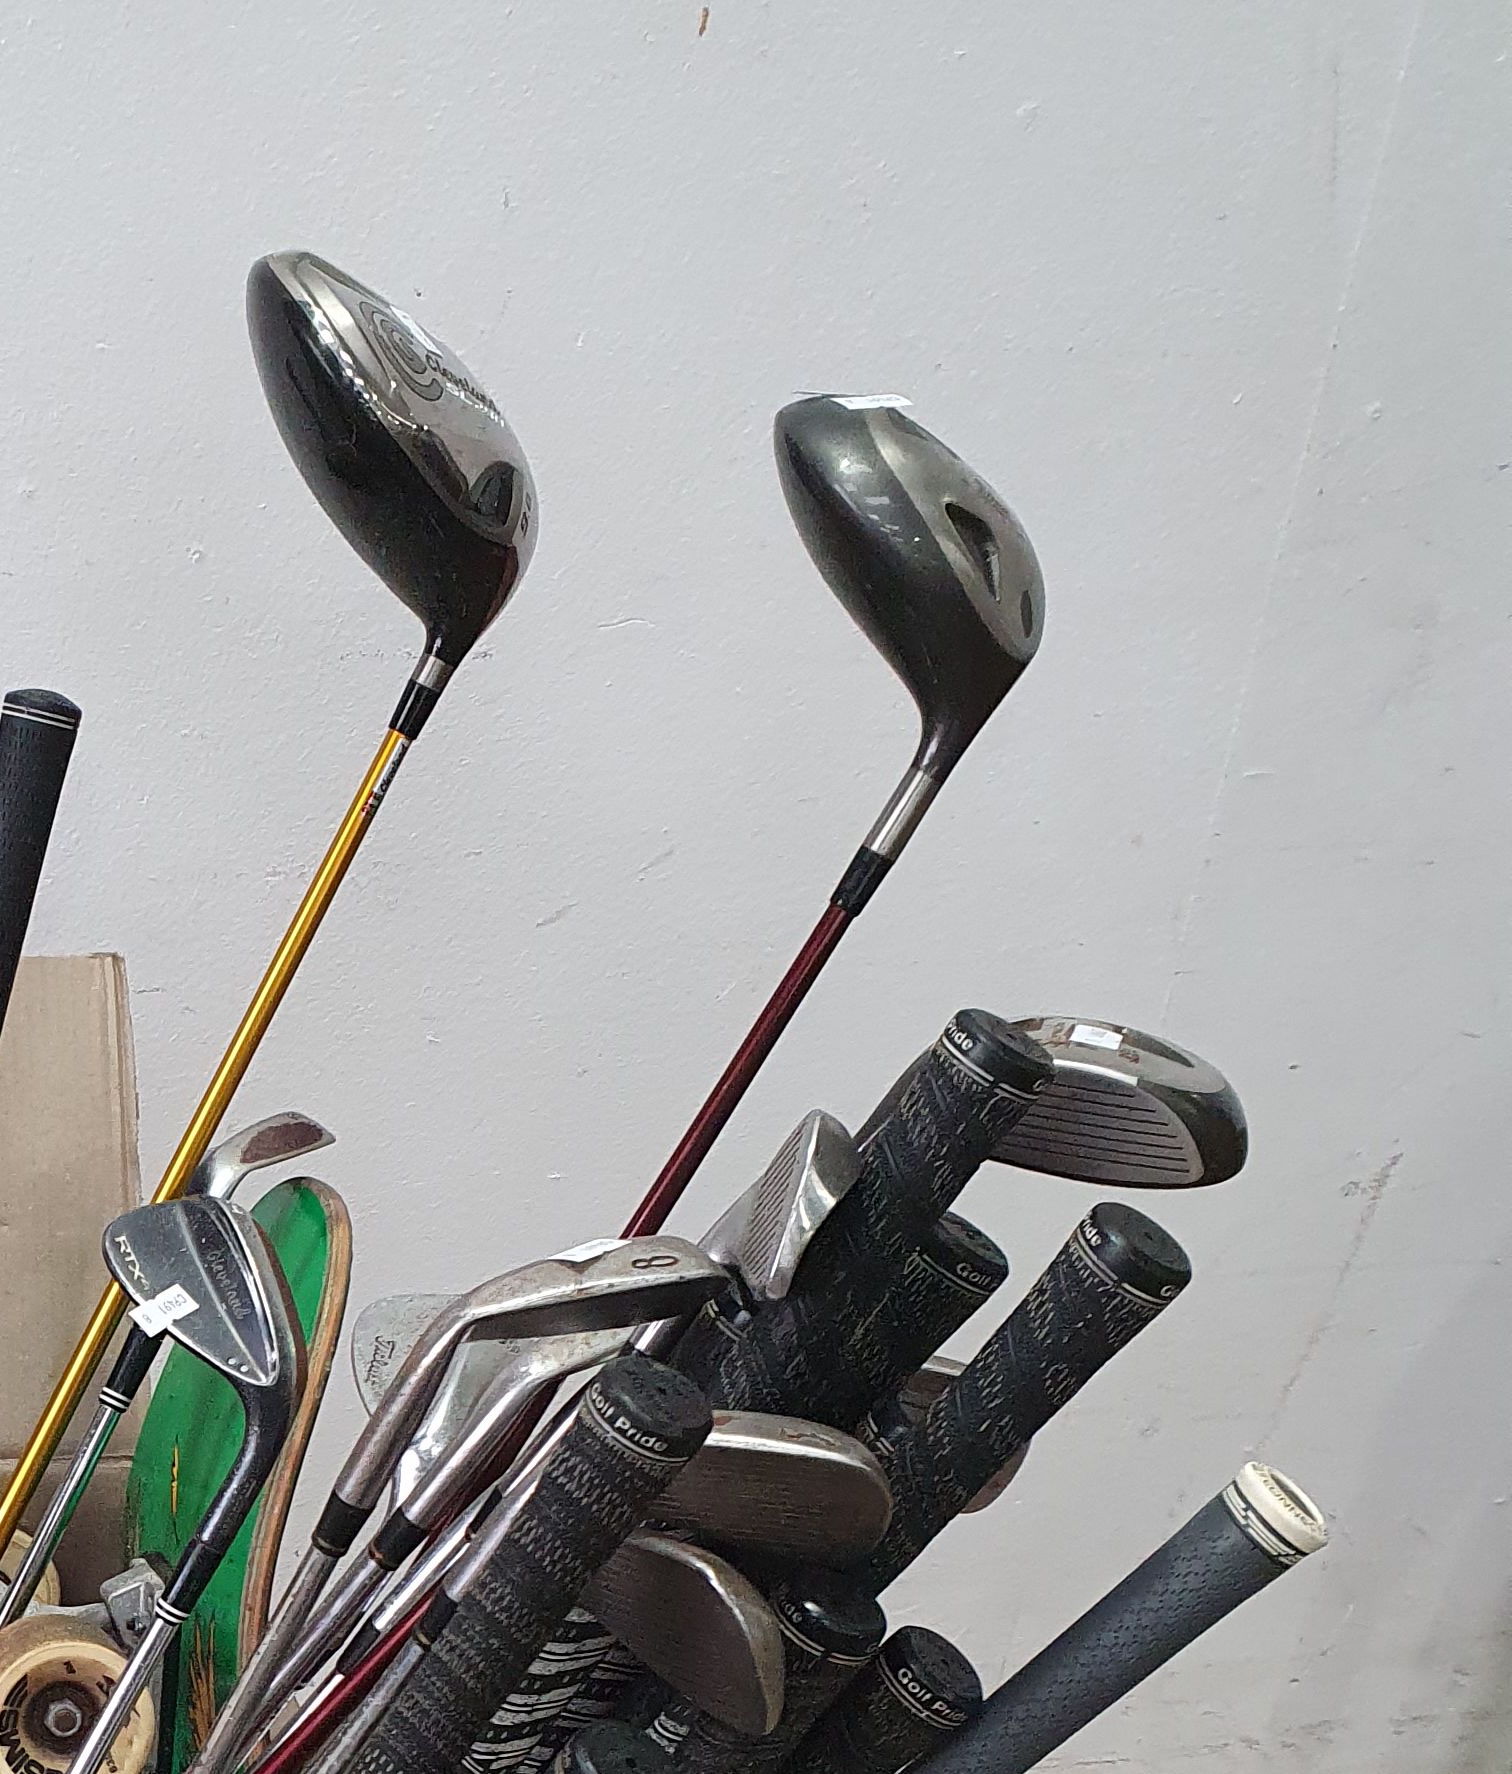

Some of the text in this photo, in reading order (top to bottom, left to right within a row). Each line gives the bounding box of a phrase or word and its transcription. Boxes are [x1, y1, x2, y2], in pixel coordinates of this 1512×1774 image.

[631, 1255, 679, 1270] 8
[613, 1415, 670, 1453] Pride
[897, 1668, 933, 1702] Golf
